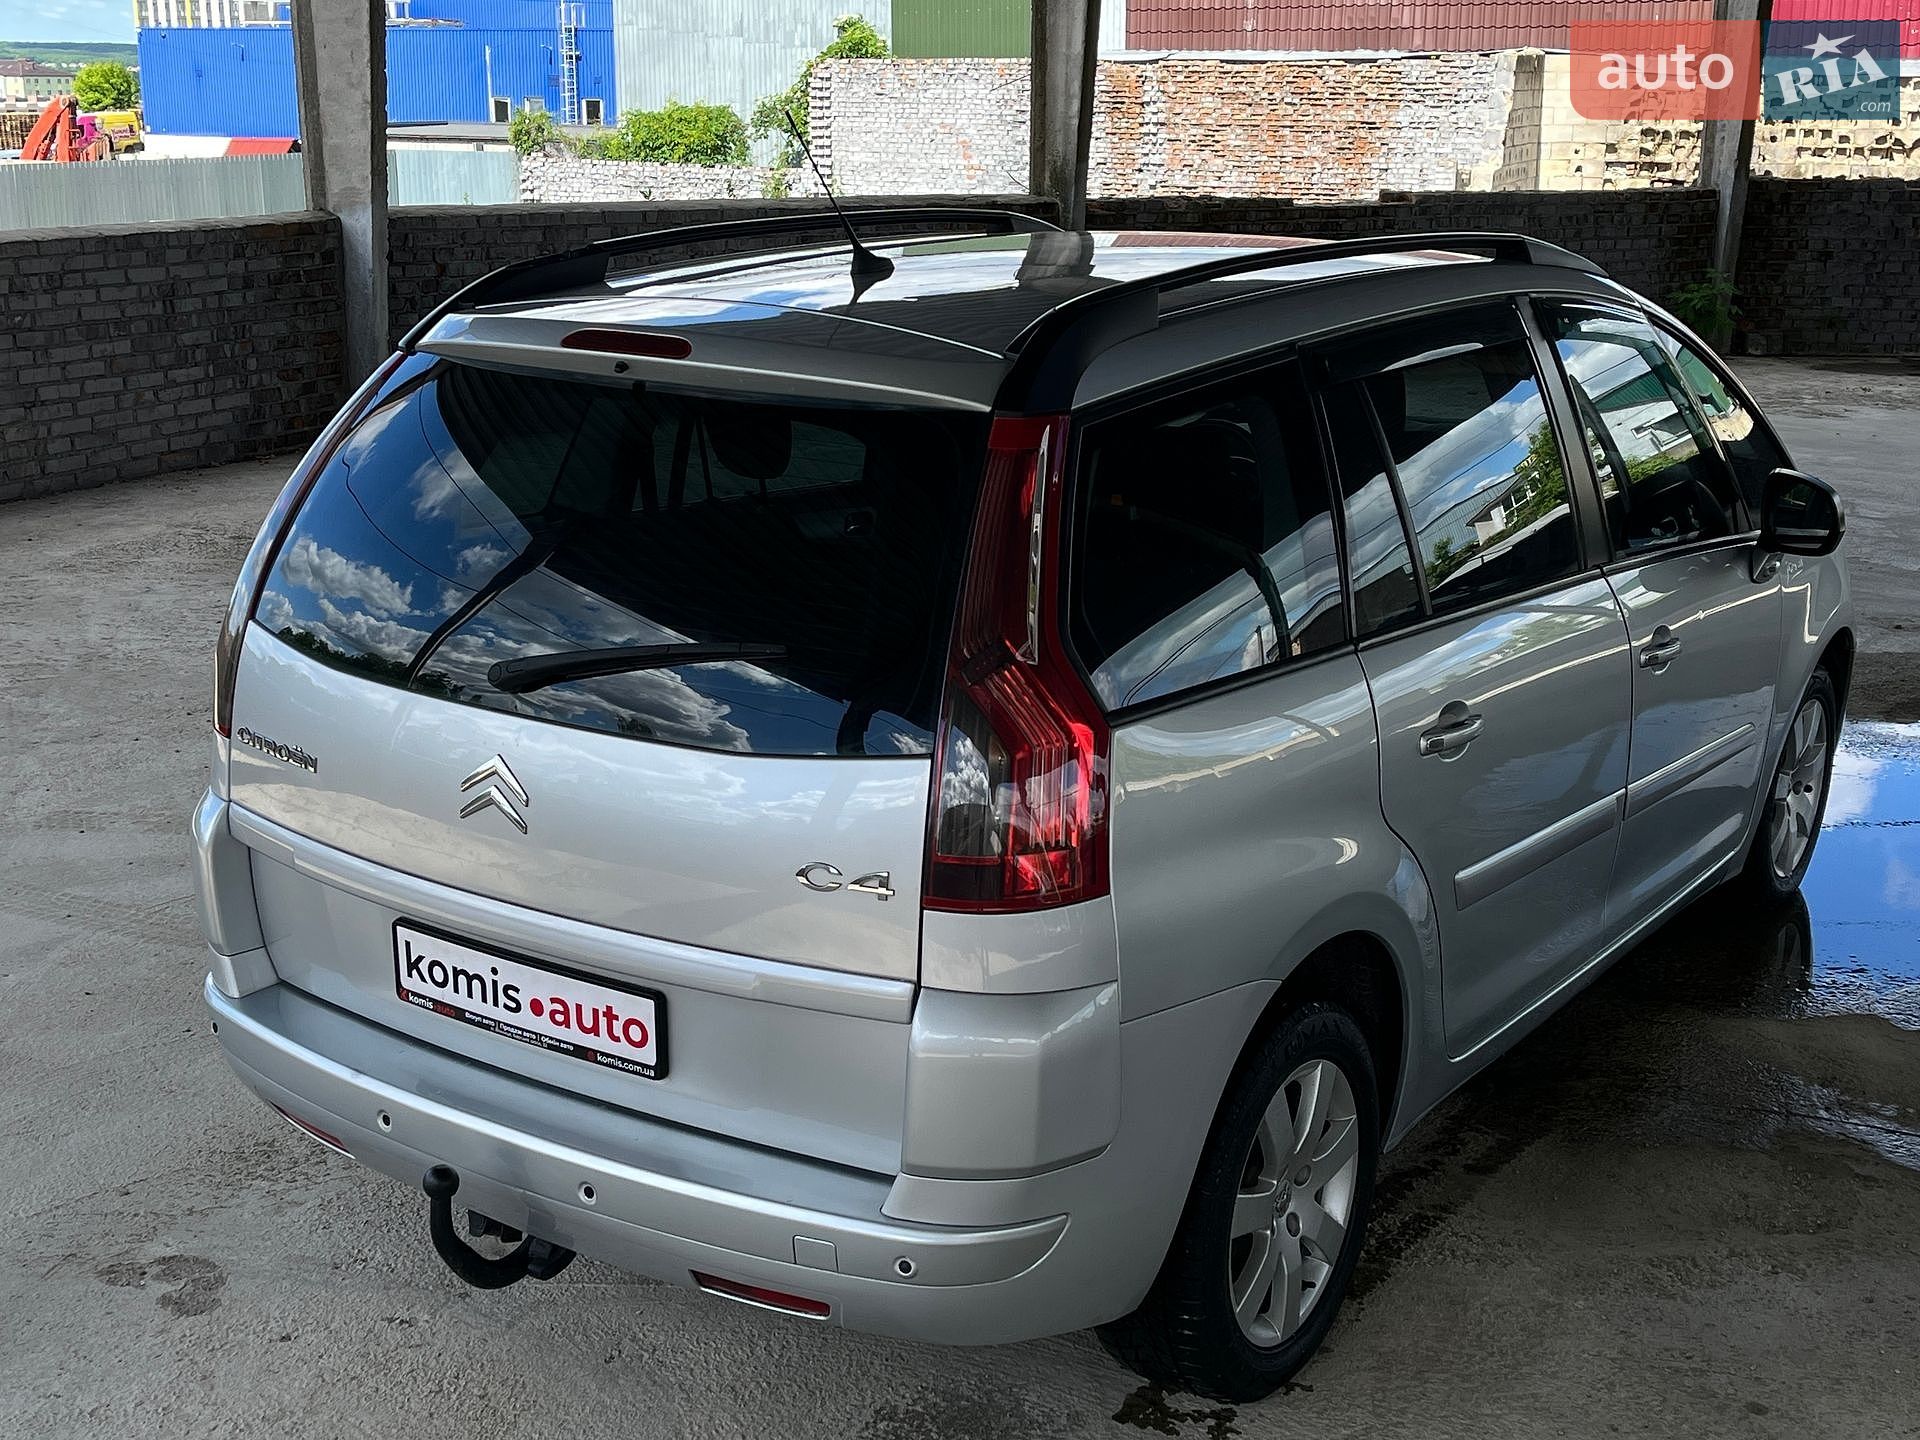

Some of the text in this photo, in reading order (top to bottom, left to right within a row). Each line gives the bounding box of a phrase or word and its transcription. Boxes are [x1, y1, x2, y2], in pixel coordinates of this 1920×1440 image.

[237, 727, 318, 773] CITROËN
[796, 862, 896, 901] C4
[404, 940, 649, 1048] komis auto
[597, 1053, 655, 1077] komis.com.ua
